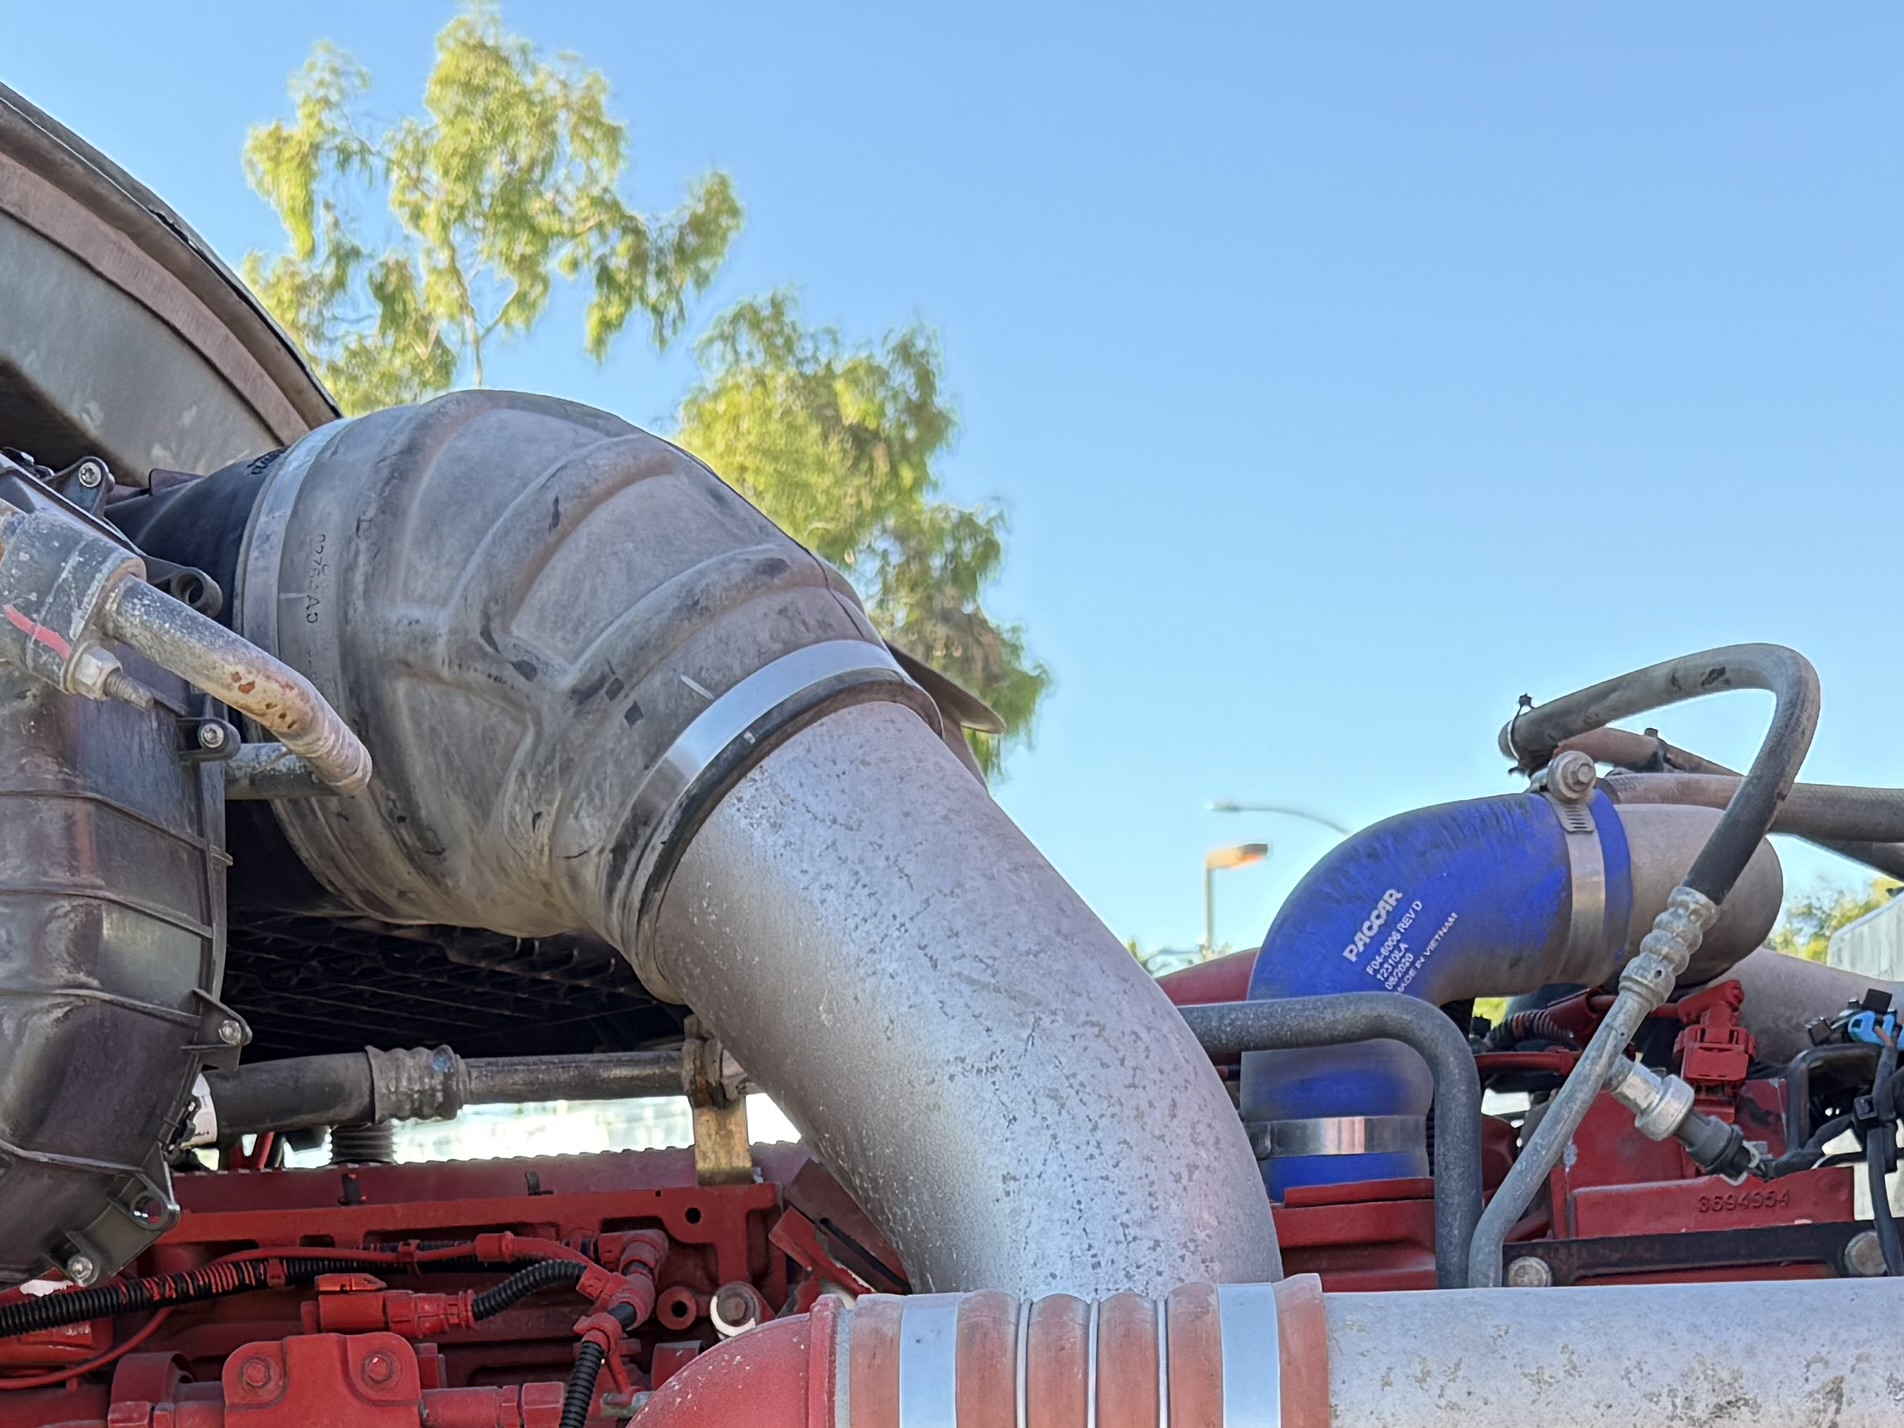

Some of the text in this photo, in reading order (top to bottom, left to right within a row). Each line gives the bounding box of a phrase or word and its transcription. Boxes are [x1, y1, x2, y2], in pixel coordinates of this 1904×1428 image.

[1342, 889, 1403, 963] PACCAR
[1397, 909, 1416, 933] REV
[1412, 901, 1422, 911] D
[1424, 912, 1458, 956] VIETNAM
[1376, 942, 1409, 981] 12310LA
